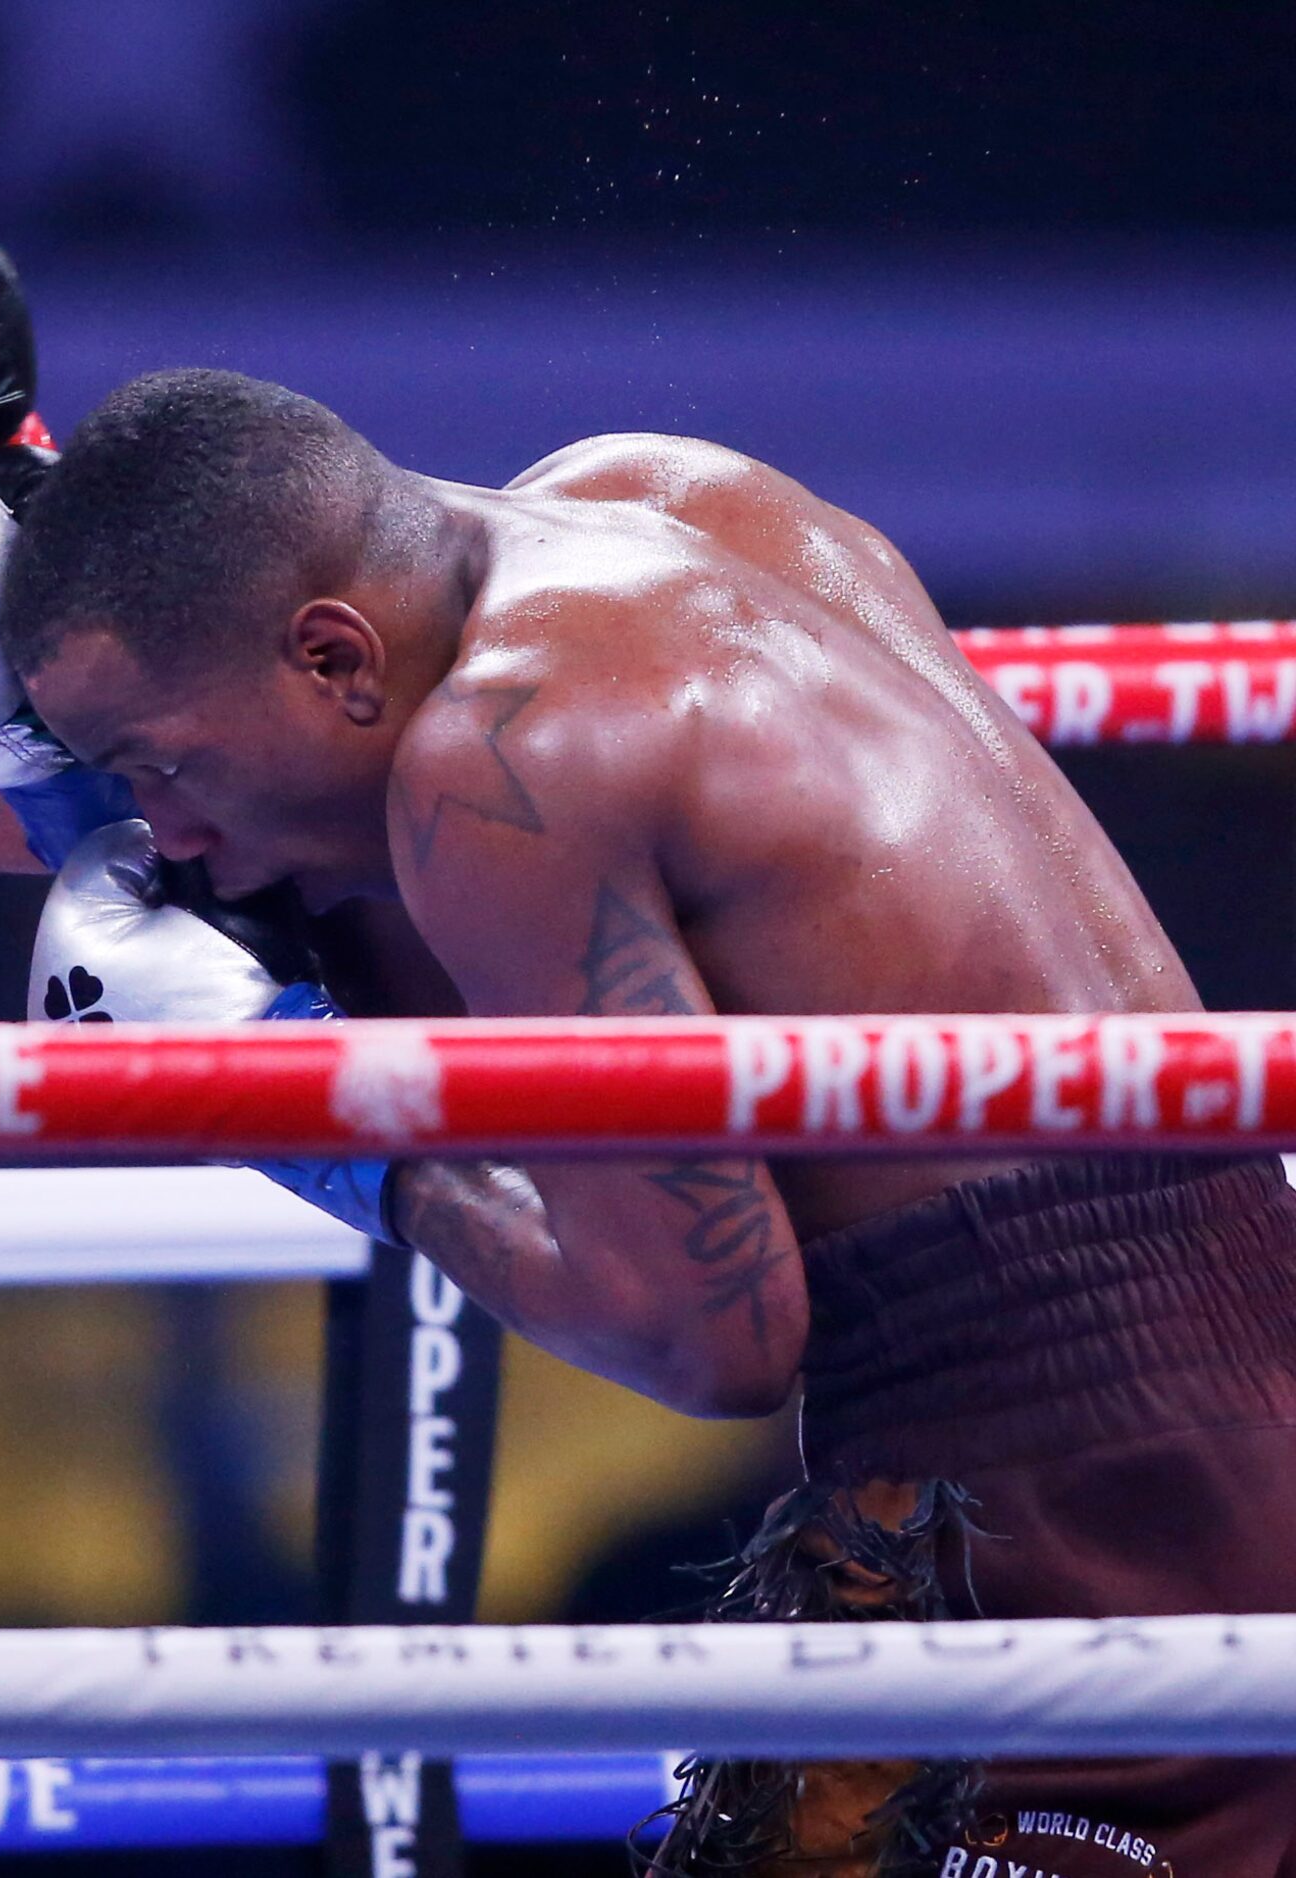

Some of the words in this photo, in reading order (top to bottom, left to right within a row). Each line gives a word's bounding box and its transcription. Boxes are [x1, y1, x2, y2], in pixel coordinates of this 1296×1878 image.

[725, 1018, 1168, 1133] PROPER
[1017, 1810, 1089, 1841] WORLD
[1094, 1823, 1157, 1867] CLASS
